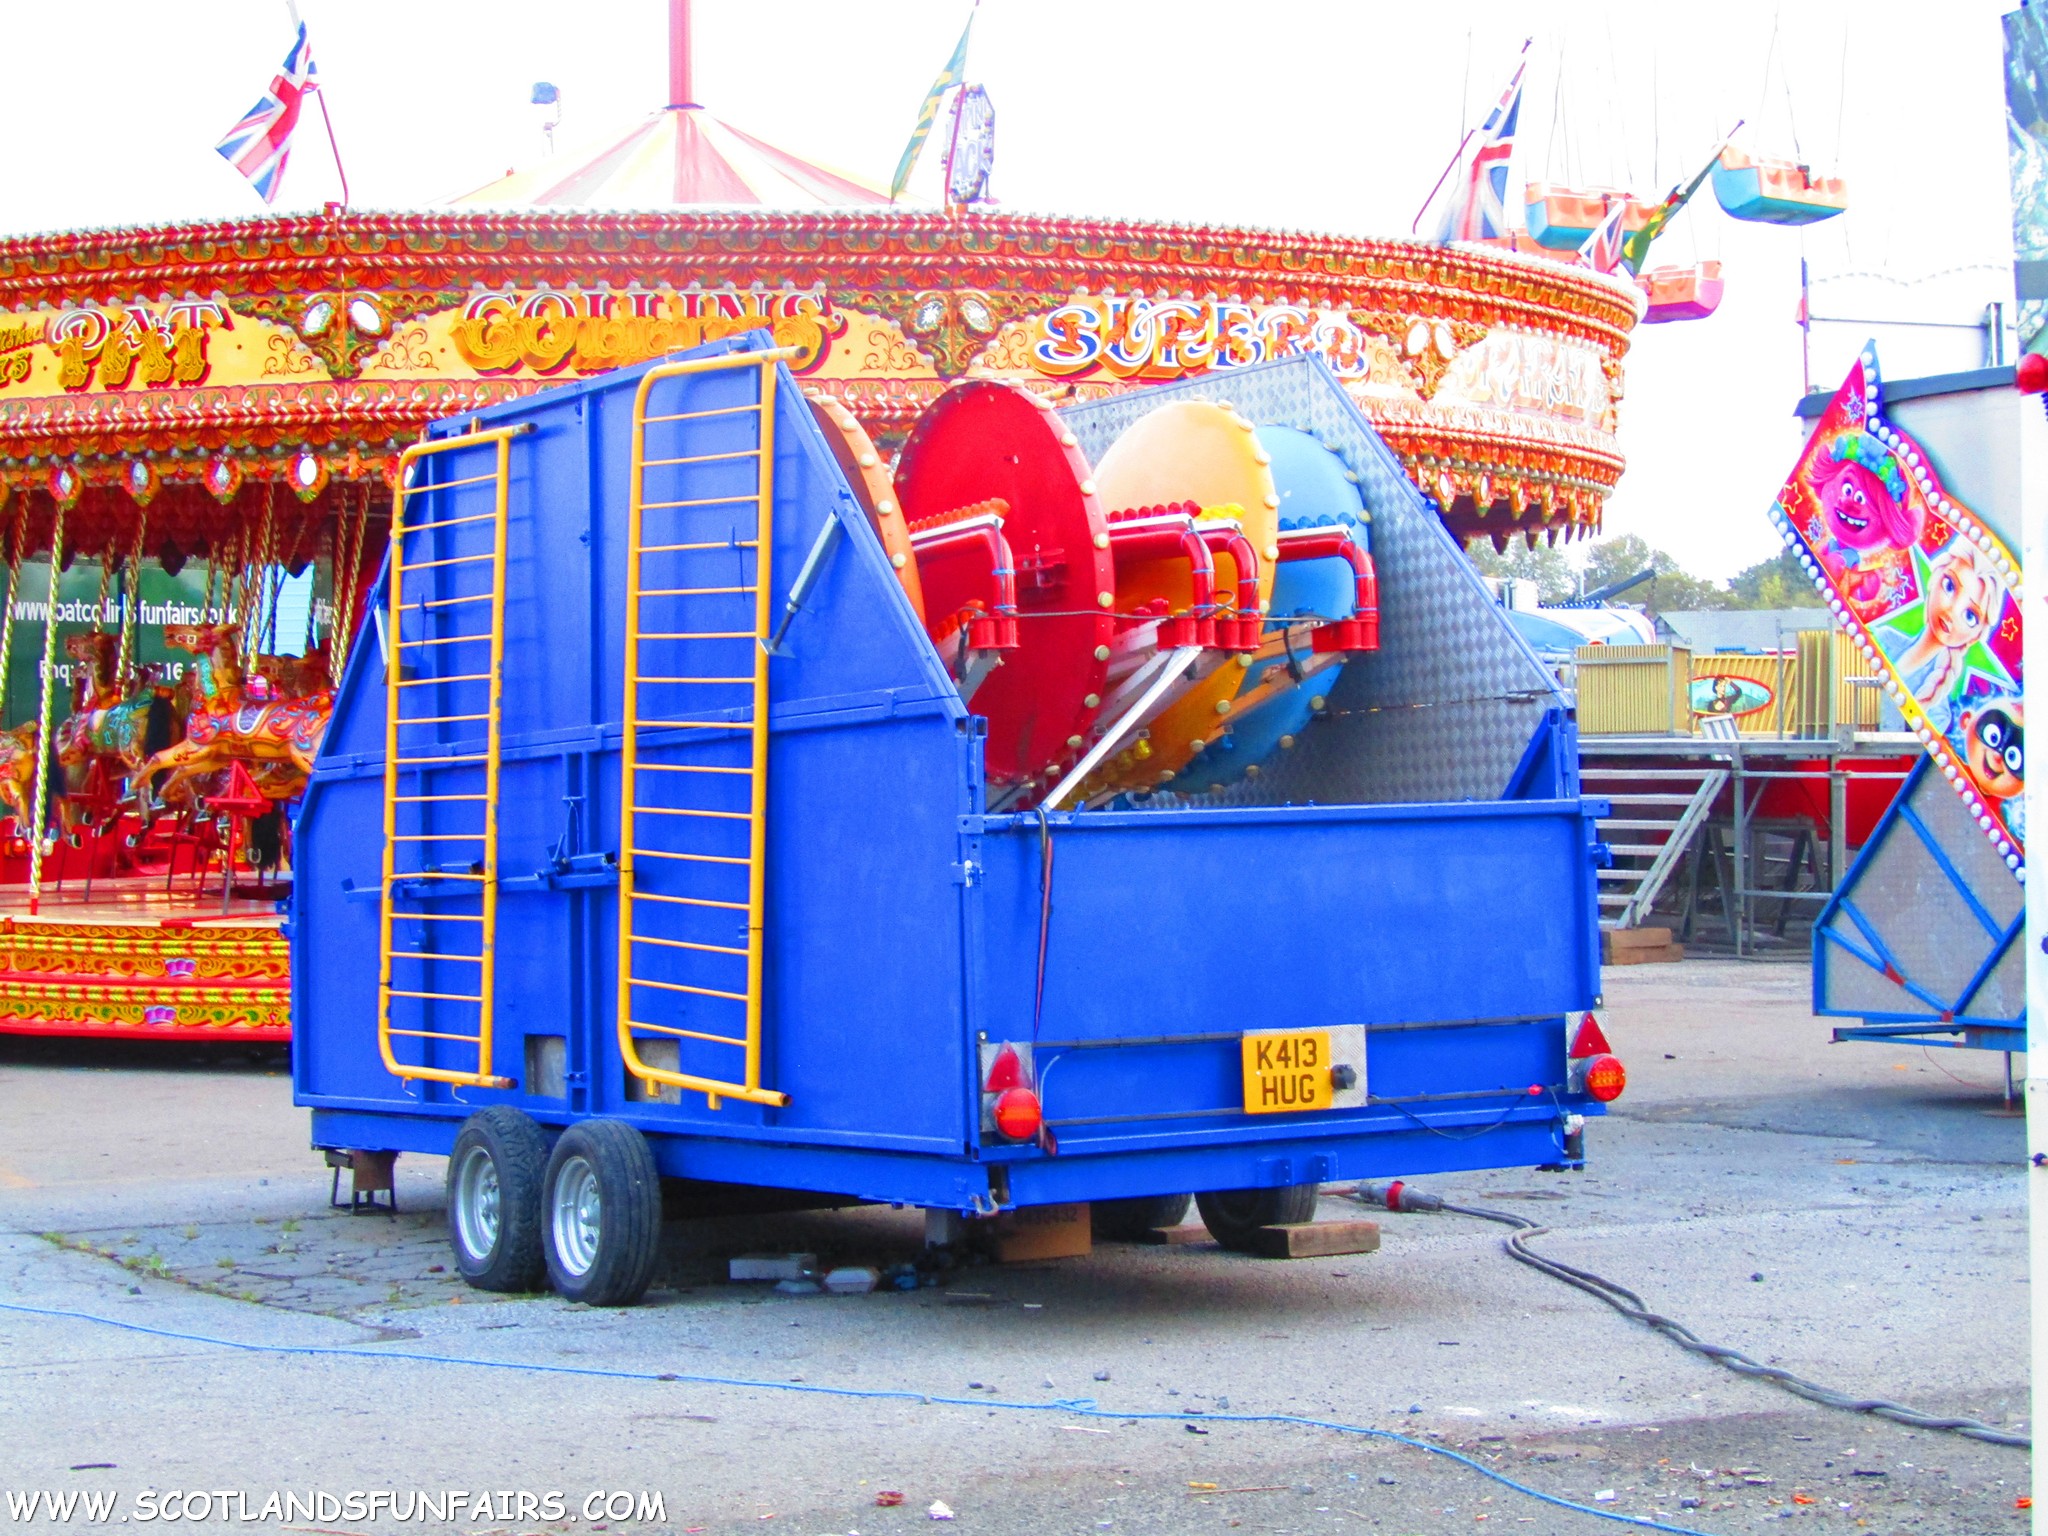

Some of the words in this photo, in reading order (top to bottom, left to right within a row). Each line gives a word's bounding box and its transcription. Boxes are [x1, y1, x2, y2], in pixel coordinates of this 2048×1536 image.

[52, 300, 226, 390] PAT
[1034, 298, 1370, 380] SUPERB
[1256, 1038, 1318, 1070] K413
[1262, 1074, 1315, 1106] HUG
